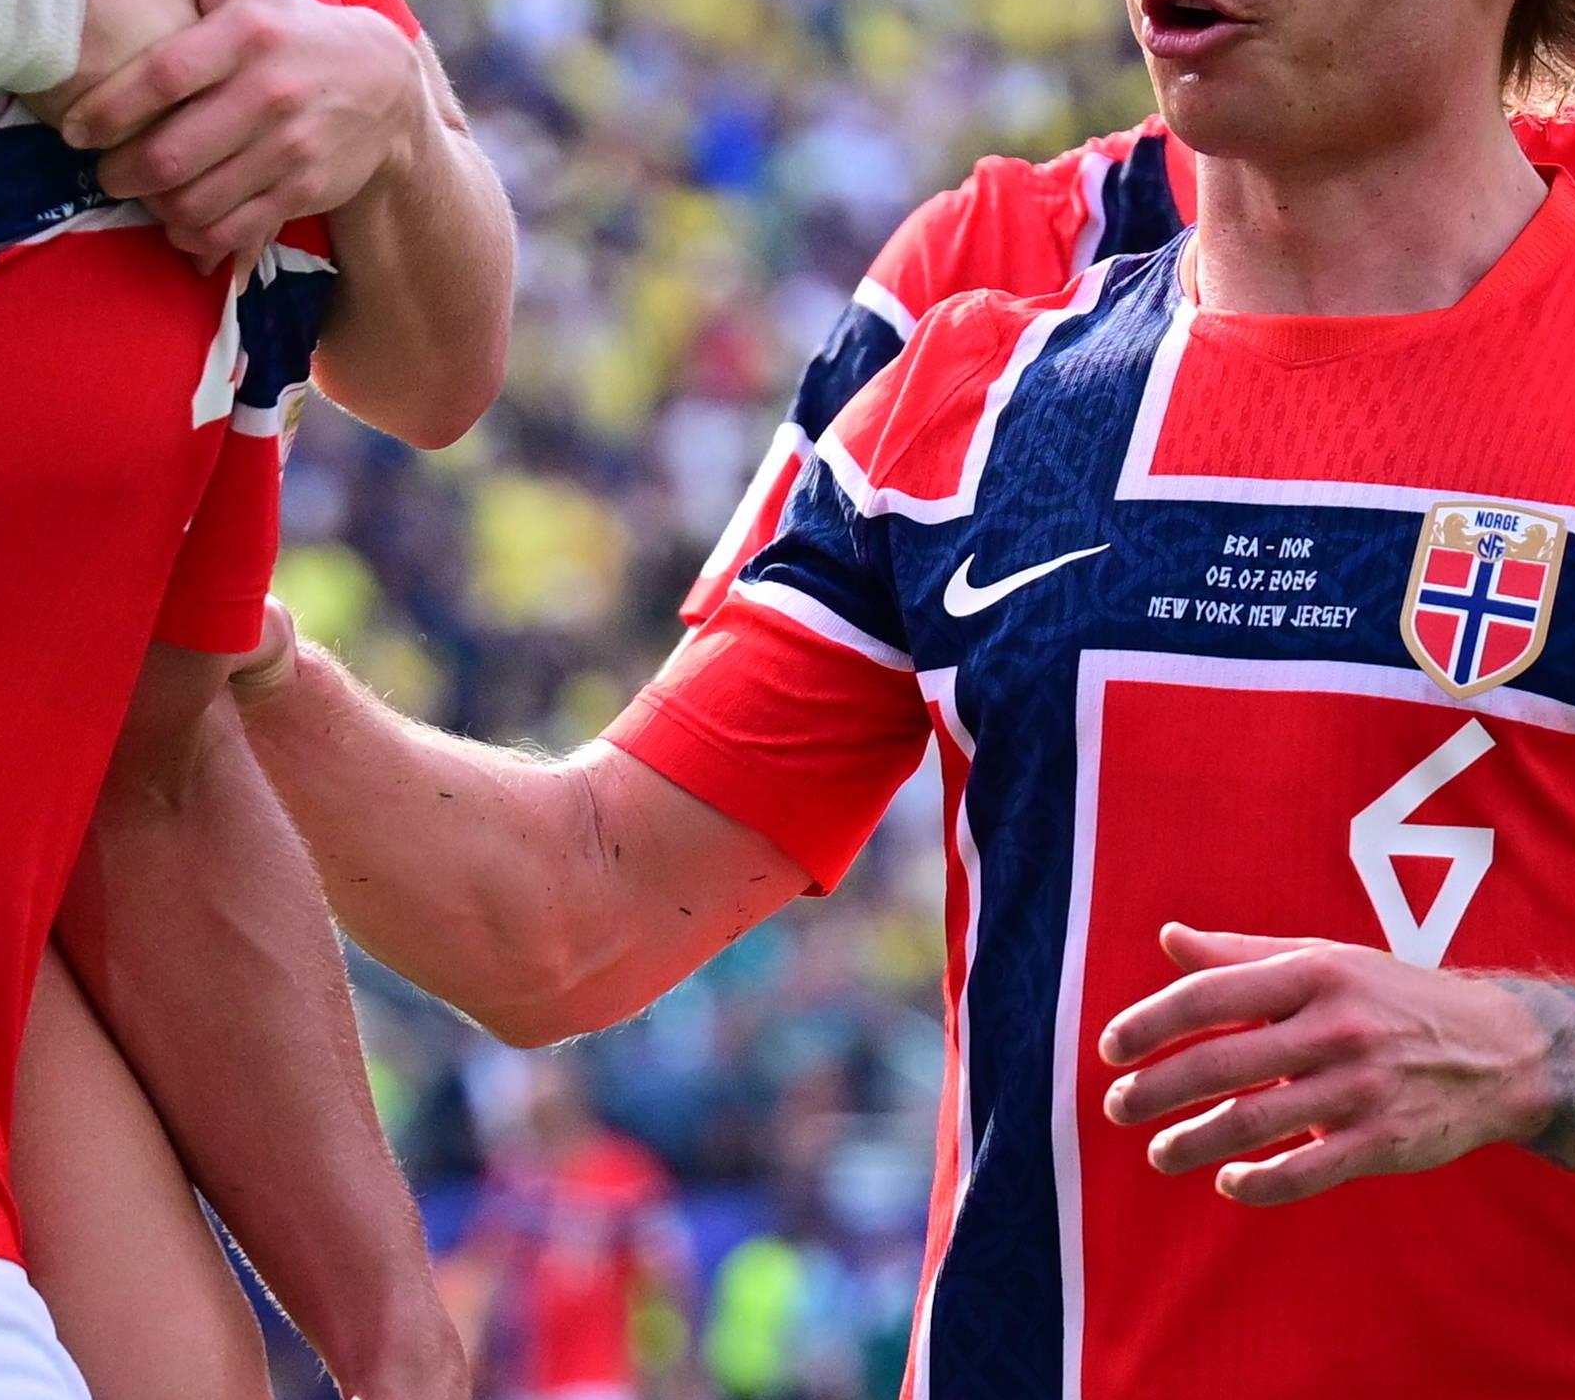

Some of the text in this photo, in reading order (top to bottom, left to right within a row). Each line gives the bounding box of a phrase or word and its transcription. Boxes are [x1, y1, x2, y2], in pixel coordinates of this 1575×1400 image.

[1474, 510, 1521, 532] NORGE
[1223, 534, 1259, 558] BRA
[1278, 537, 1314, 558] NOR
[1205, 565, 1317, 591] 05.07.2026
[1147, 596, 1357, 628] NEW YORK NEW JERSEY
[1348, 716, 1498, 970] 6
